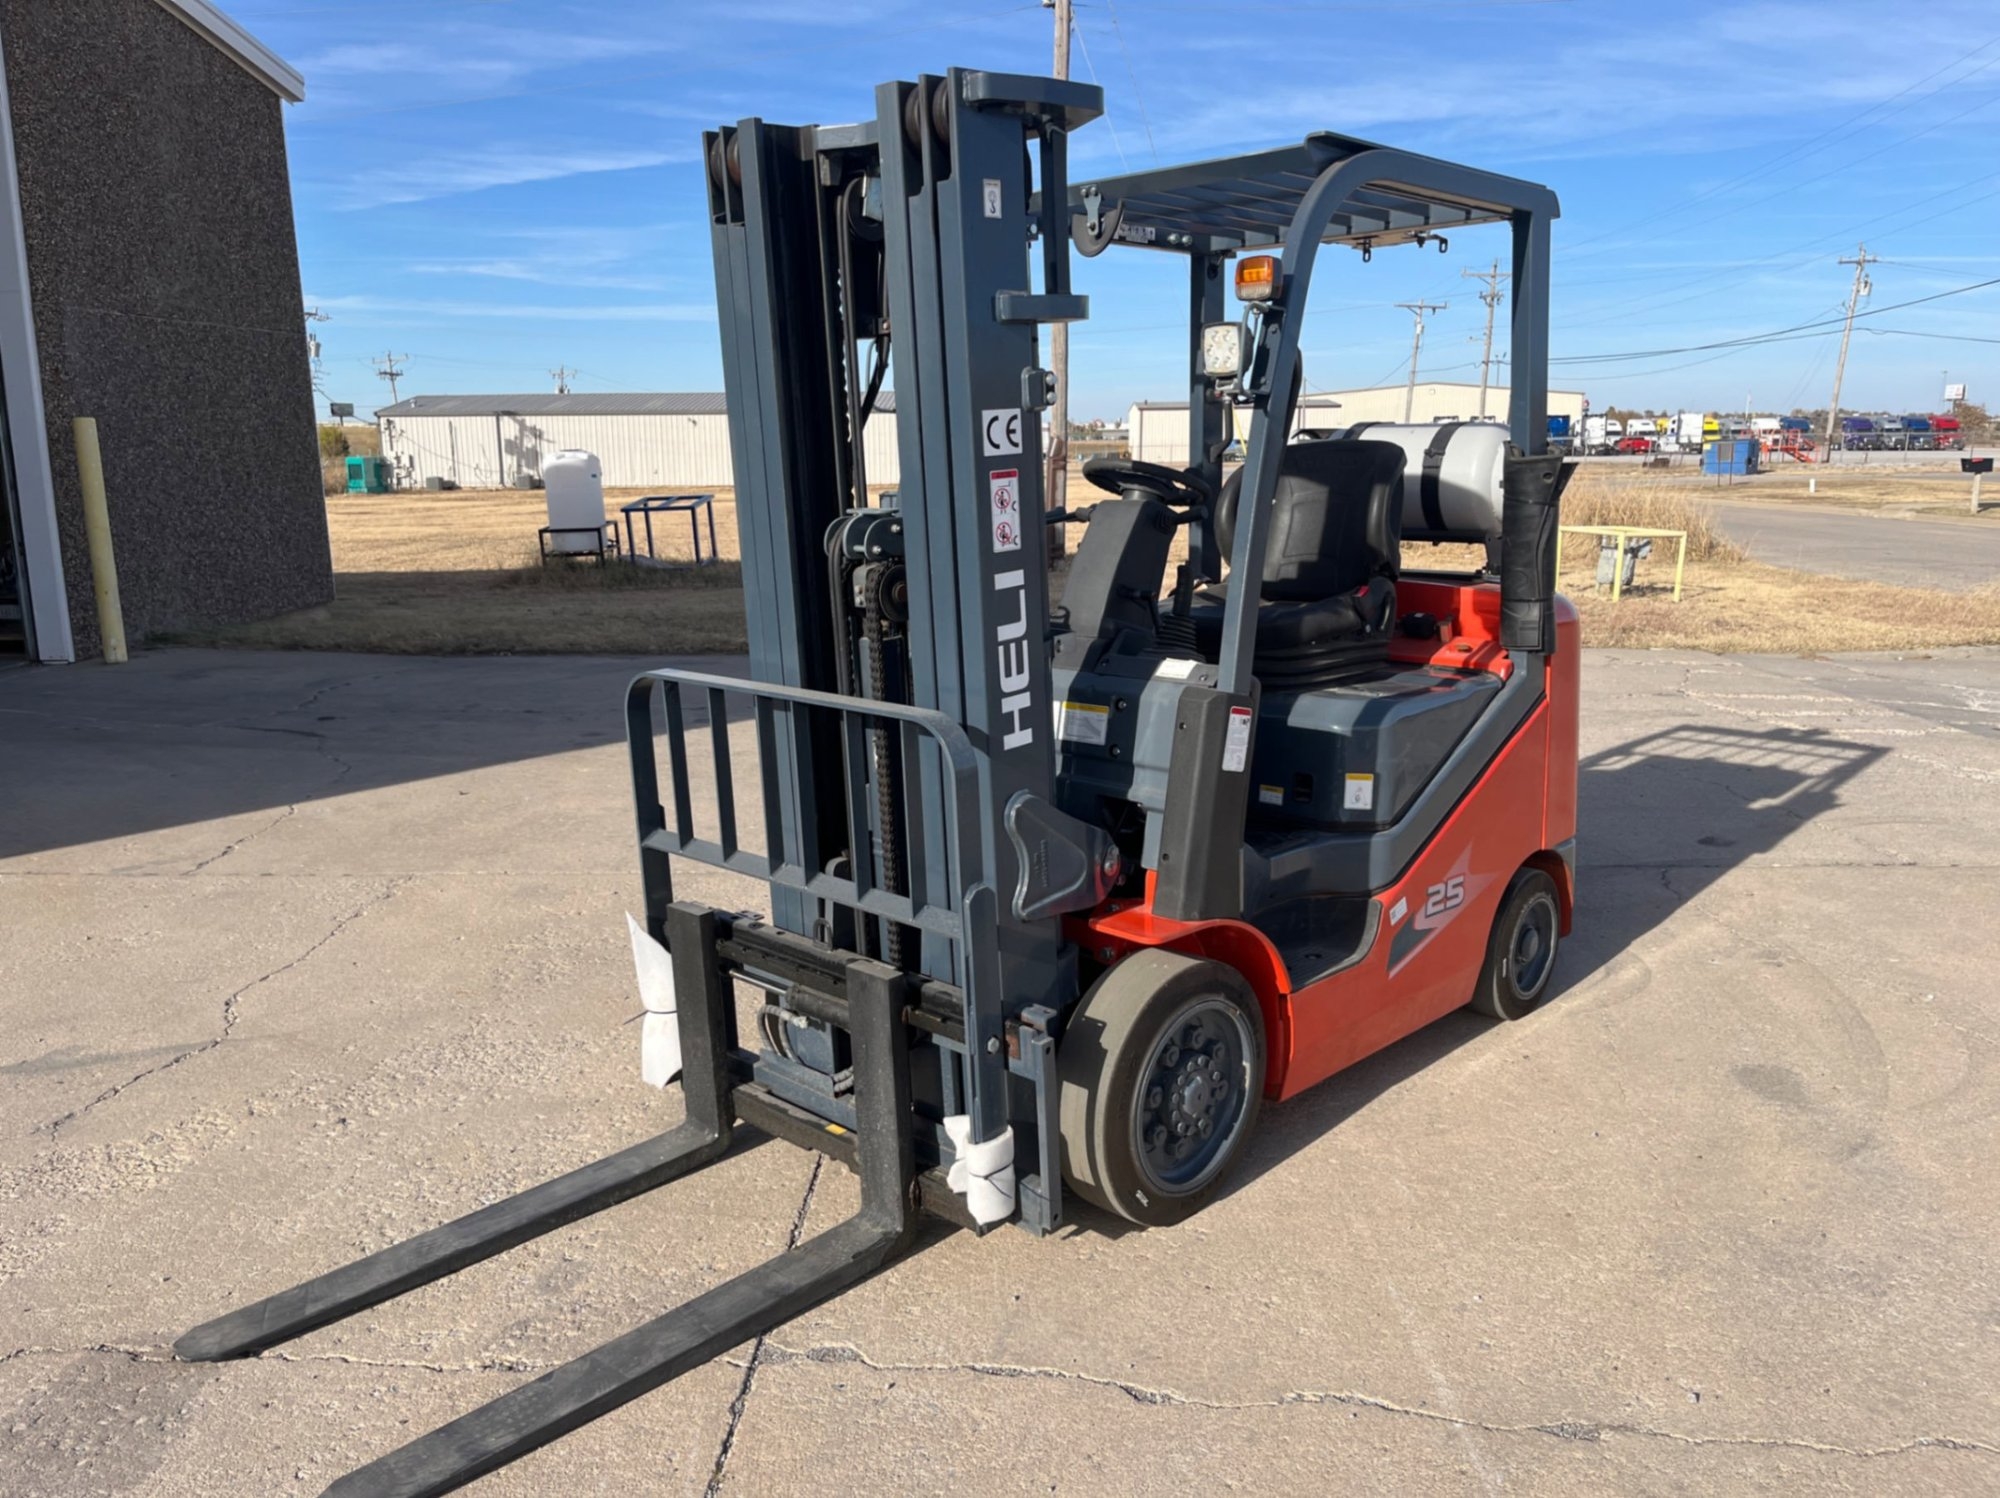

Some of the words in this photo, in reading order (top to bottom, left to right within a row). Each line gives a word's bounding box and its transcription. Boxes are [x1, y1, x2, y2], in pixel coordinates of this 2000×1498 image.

[986, 414, 1019, 449] CE
[994, 569, 1033, 751] HELI
[1426, 874, 1465, 919] 25
